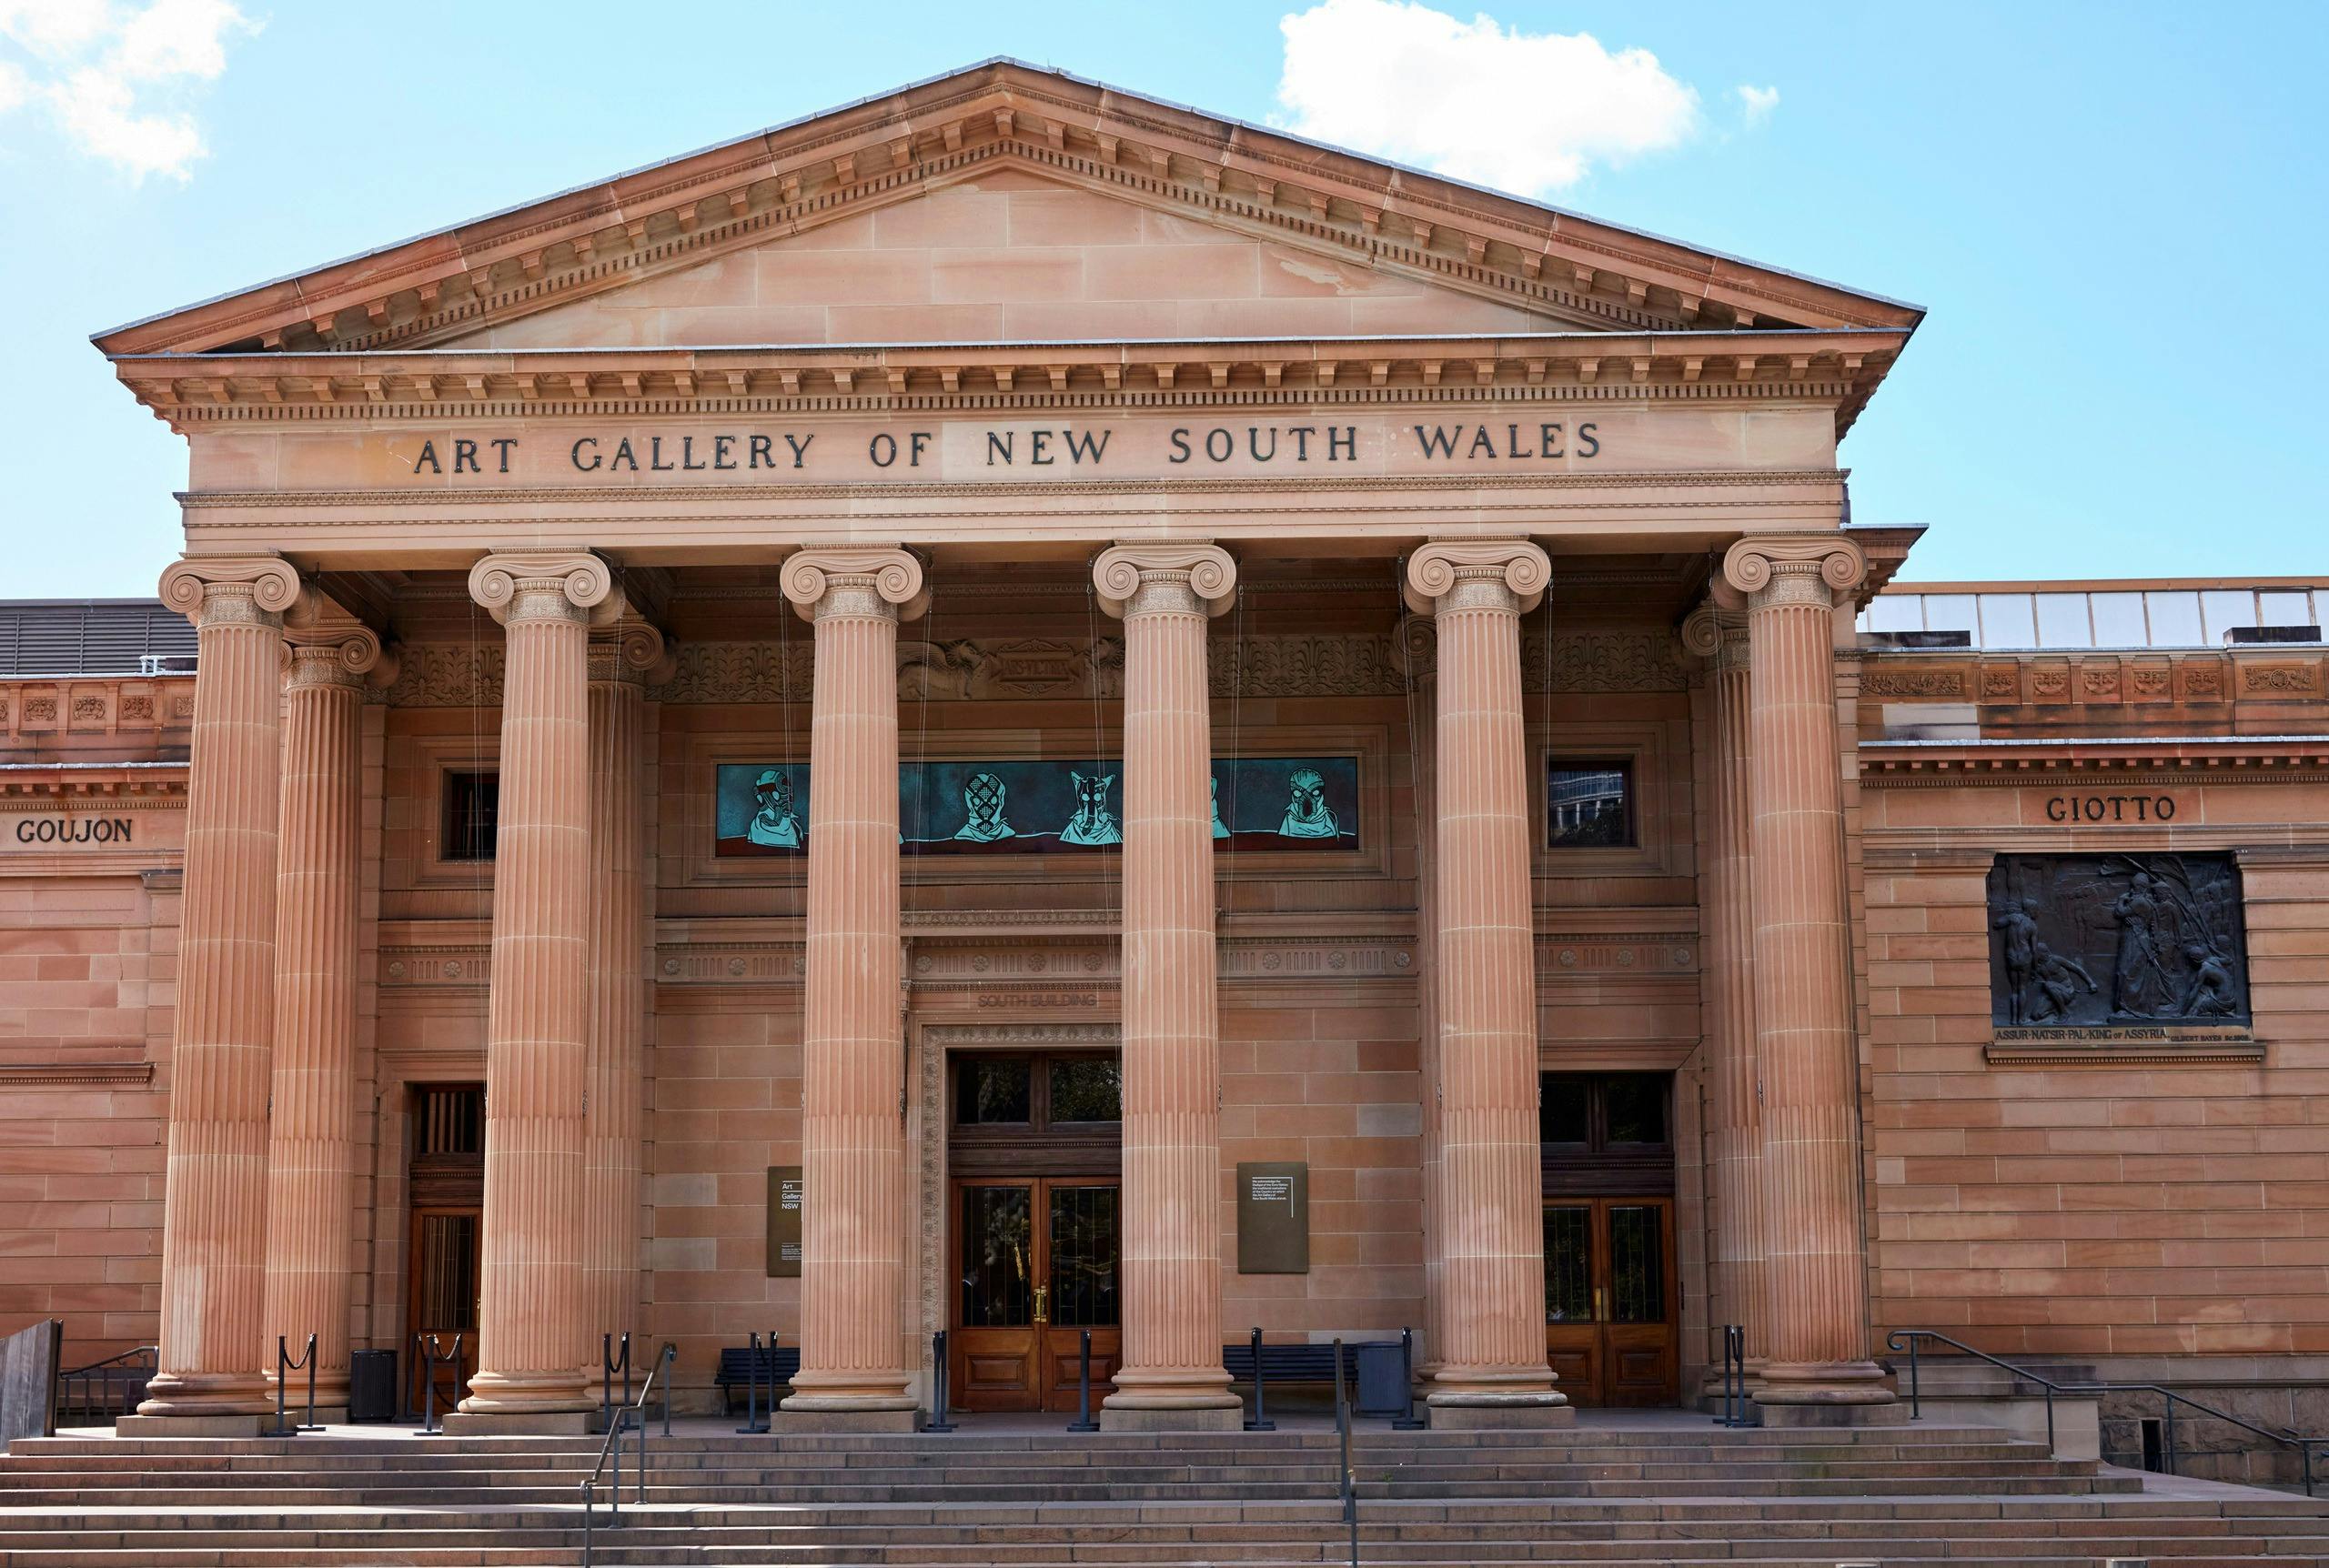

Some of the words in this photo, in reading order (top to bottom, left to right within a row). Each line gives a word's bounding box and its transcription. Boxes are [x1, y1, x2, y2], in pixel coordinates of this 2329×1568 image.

[414, 438, 517, 473] ART
[572, 434, 813, 471] GALLERY
[870, 433, 931, 467] OF
[987, 430, 1111, 465] NEW
[1169, 427, 1356, 463] SOUTH
[1415, 423, 1599, 458] WALES
[2046, 796, 2175, 821] GIOTTO
[16, 819, 132, 843] GOUJON
[978, 995, 1027, 1008] SOUTH
[1031, 994, 1097, 1007] BUILDING
